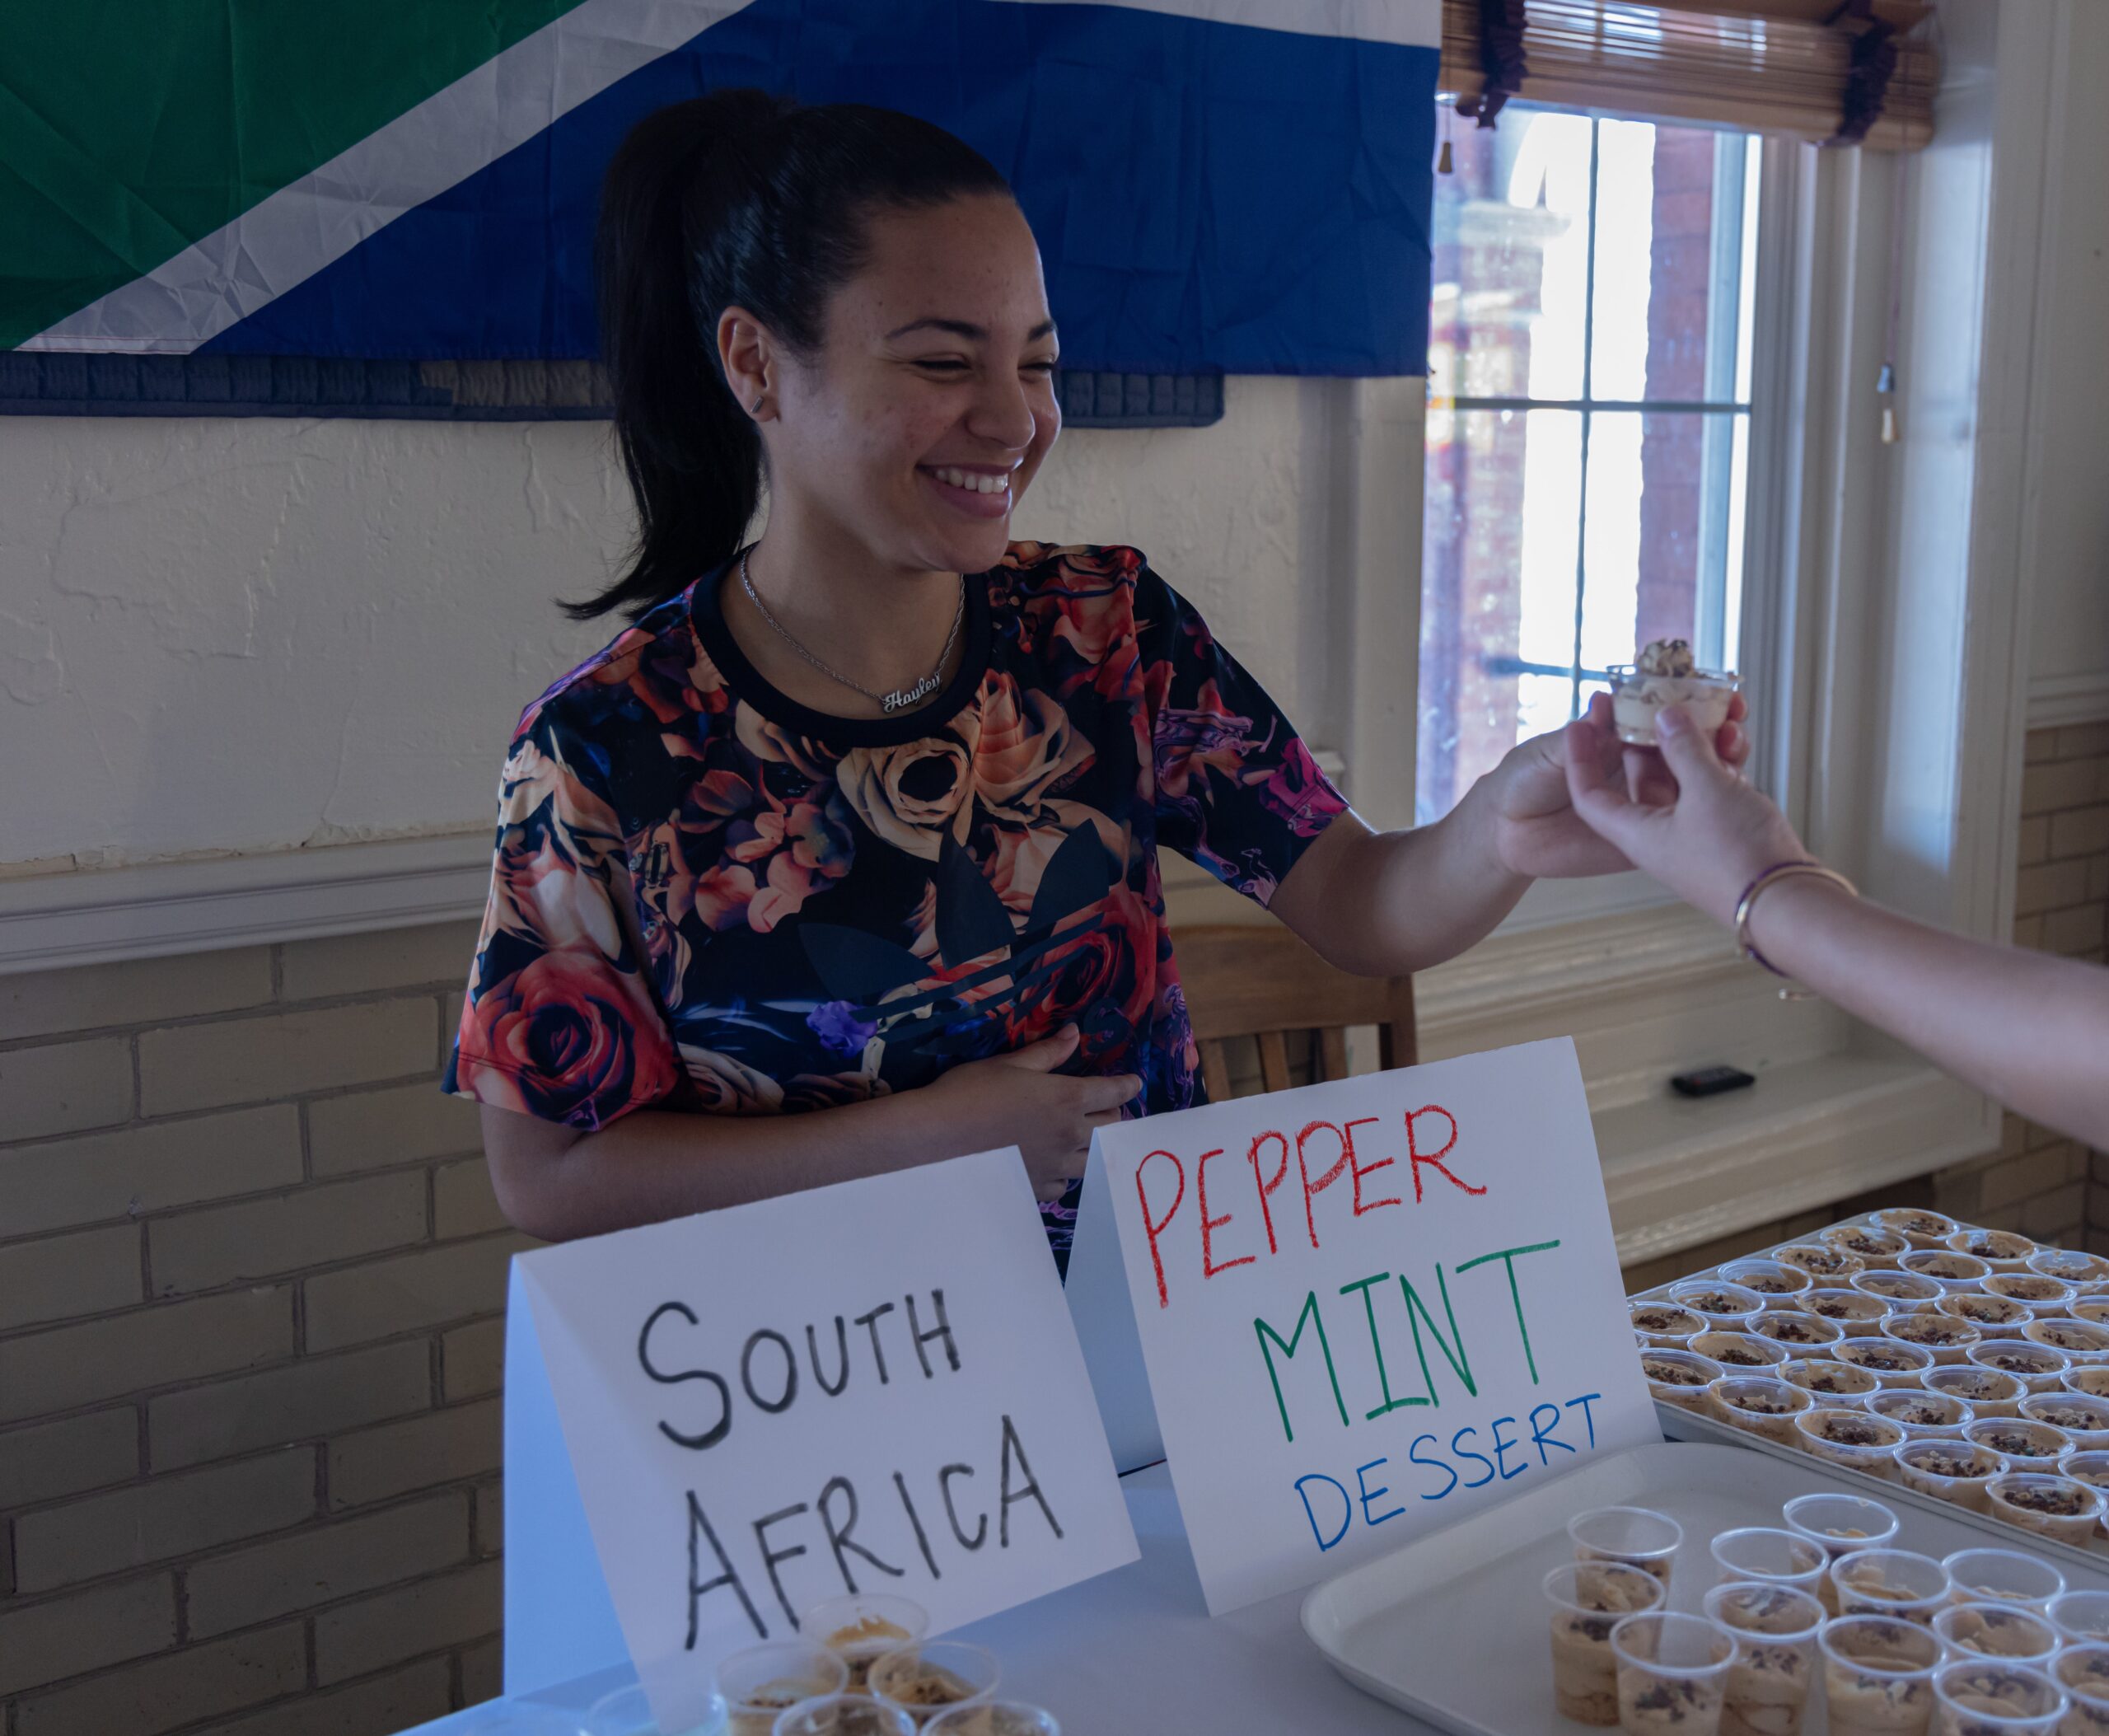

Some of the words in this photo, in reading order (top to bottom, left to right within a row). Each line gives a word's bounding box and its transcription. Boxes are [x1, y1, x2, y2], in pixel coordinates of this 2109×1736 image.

[883, 671, 943, 714] Hayley
[1135, 1104, 1487, 1308] PEPPER
[638, 1288, 961, 1450] SOUTH
[1253, 1239, 1560, 1442] MINT
[684, 1414, 1064, 1651] AFRICA
[1293, 1392, 1602, 1552] DESSERT
